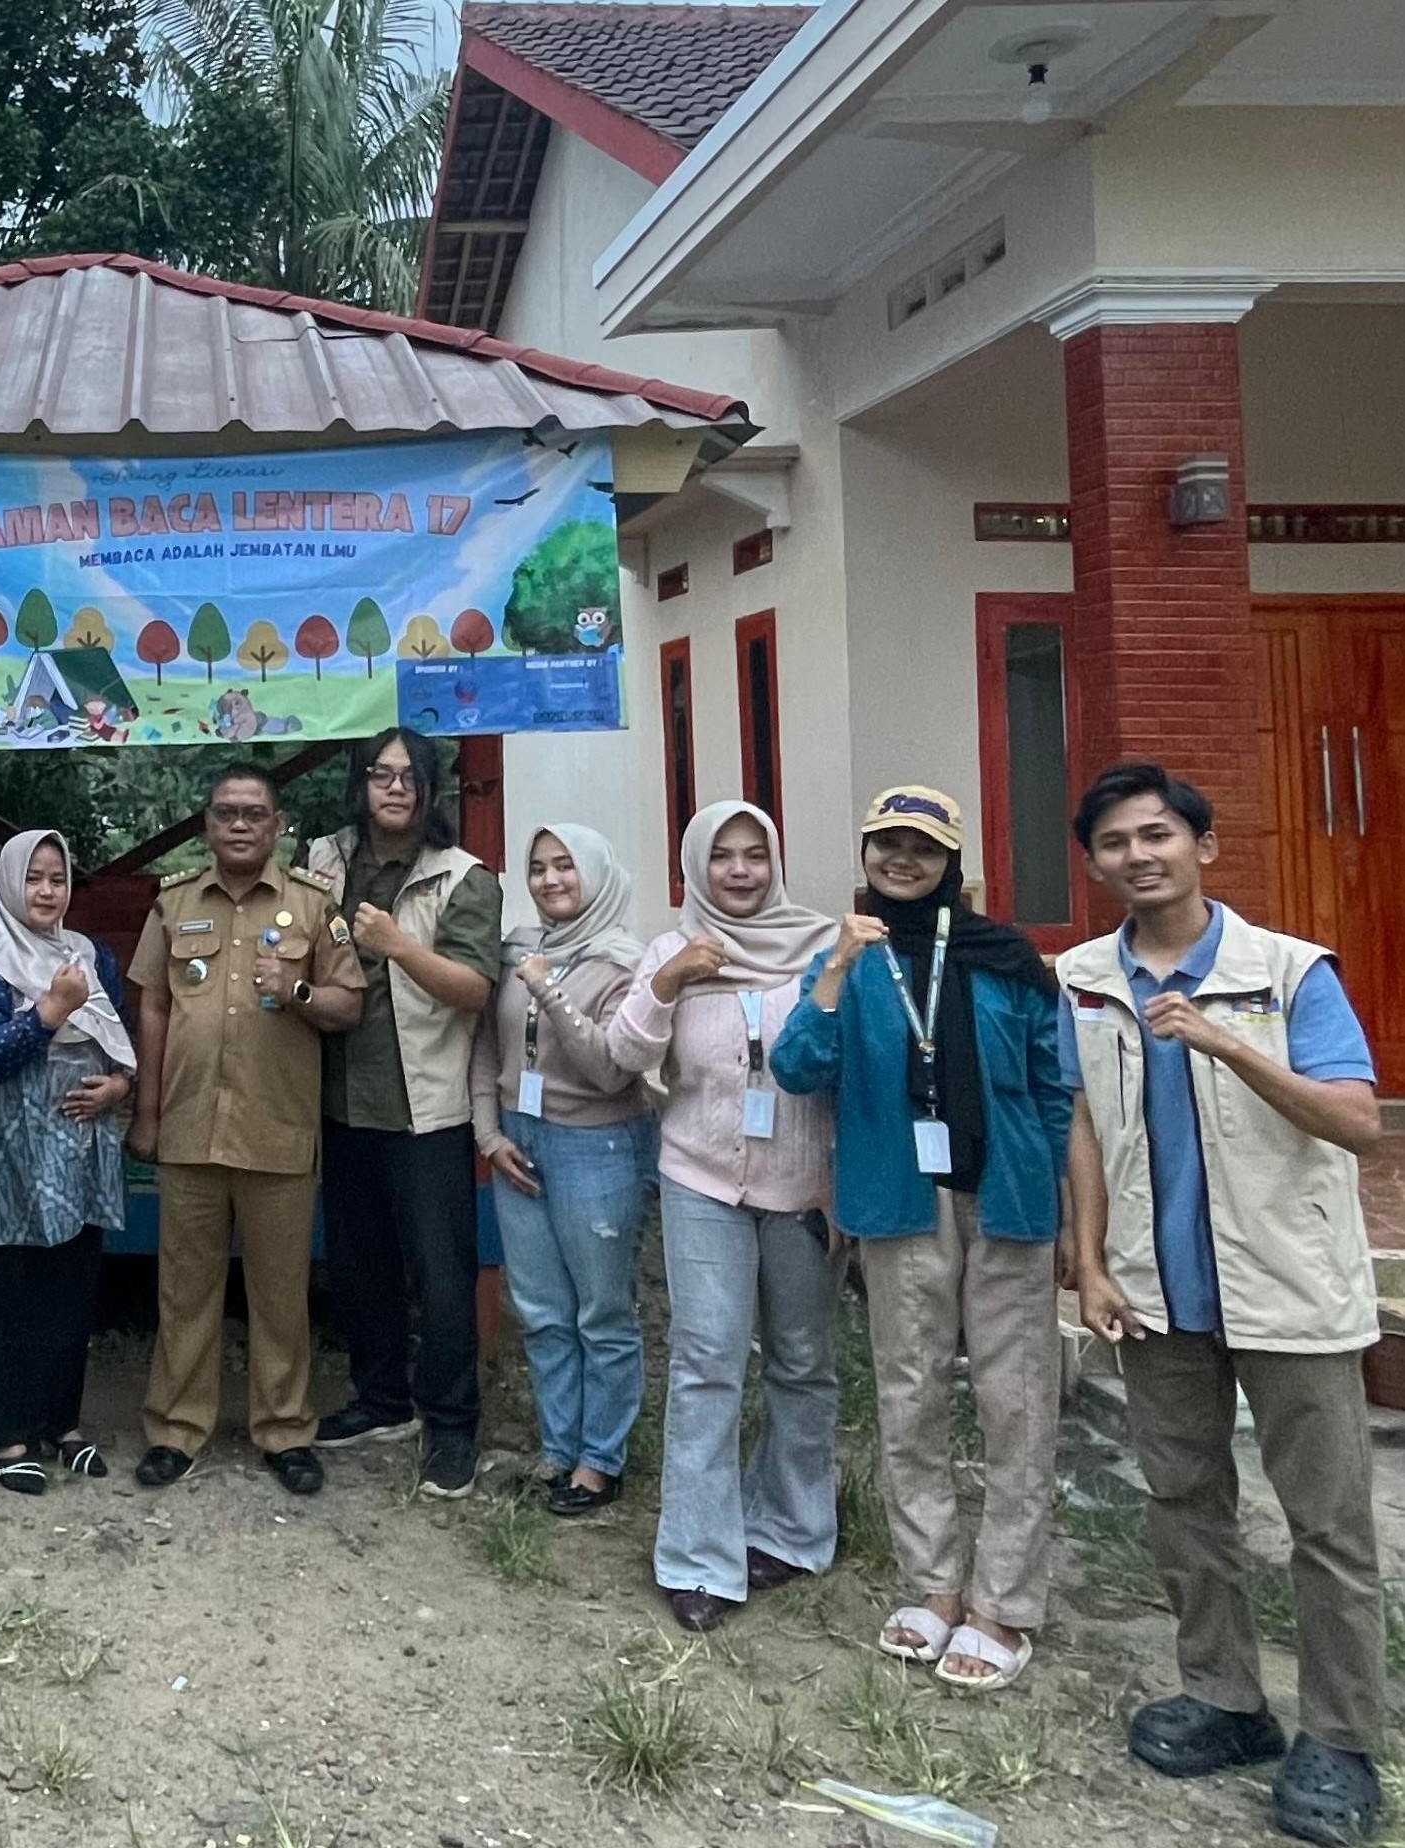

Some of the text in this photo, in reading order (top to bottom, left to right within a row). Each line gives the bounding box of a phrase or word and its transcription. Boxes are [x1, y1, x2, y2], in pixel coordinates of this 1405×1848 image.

[108, 491, 223, 538] BACA
[231, 490, 414, 535] LENTERA
[426, 494, 471, 537] 17
[79, 543, 357, 568] MEMBACA ADALAH JEMBATAN ILMU
